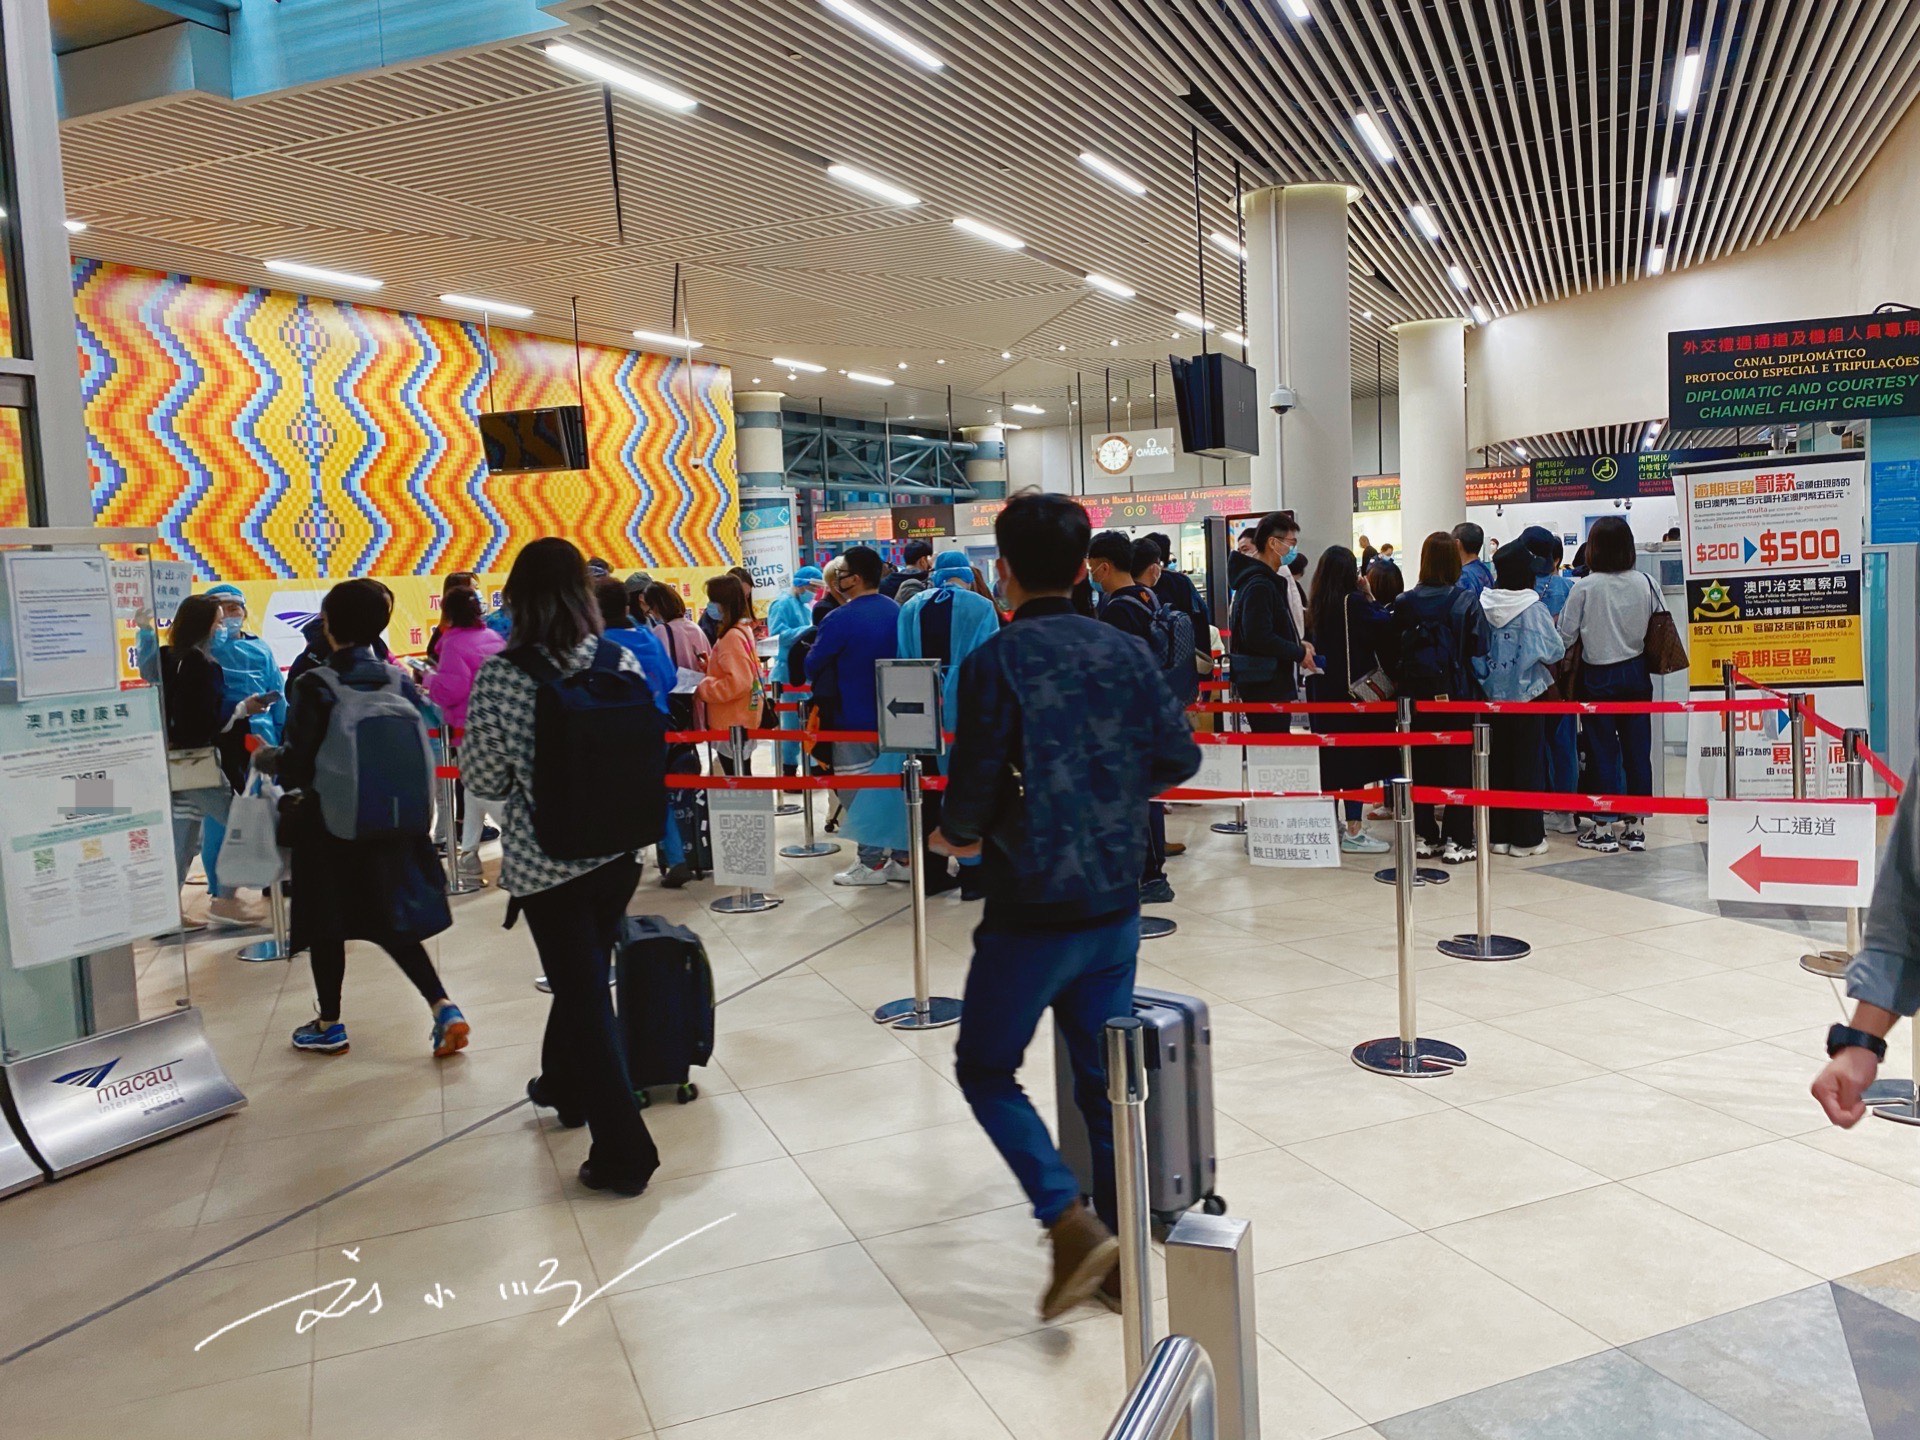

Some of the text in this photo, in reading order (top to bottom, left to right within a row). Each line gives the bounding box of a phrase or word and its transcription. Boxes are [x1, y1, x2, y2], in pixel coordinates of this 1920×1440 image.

[1734, 347, 1867, 368] CANAL DIPLOMÁTICO
[1685, 356, 1920, 384] PROTOCOLO ESPECIAL E TRIPULAÇÕES
[1685, 374, 1919, 404] DIPLOMATIC AND COURTESY
[1699, 393, 1904, 419] CHANNEL FLIGHT CREWS
[1136, 446, 1169, 457] OMEGA
[1136, 491, 1187, 502] International
[1696, 543, 1739, 563] $200
[1759, 528, 1840, 566] $500
[1744, 576, 1847, 594] 澳門治安警察局
[1802, 631, 1847, 640] permanência
[1781, 667, 1821, 676] Overstay
[25, 703, 129, 729] 澳門健康碼
[1747, 815, 1836, 836] 人工通道
[96, 1066, 173, 1103] macau
[99, 1080, 178, 1113] international
[140, 1089, 183, 1108] airport
